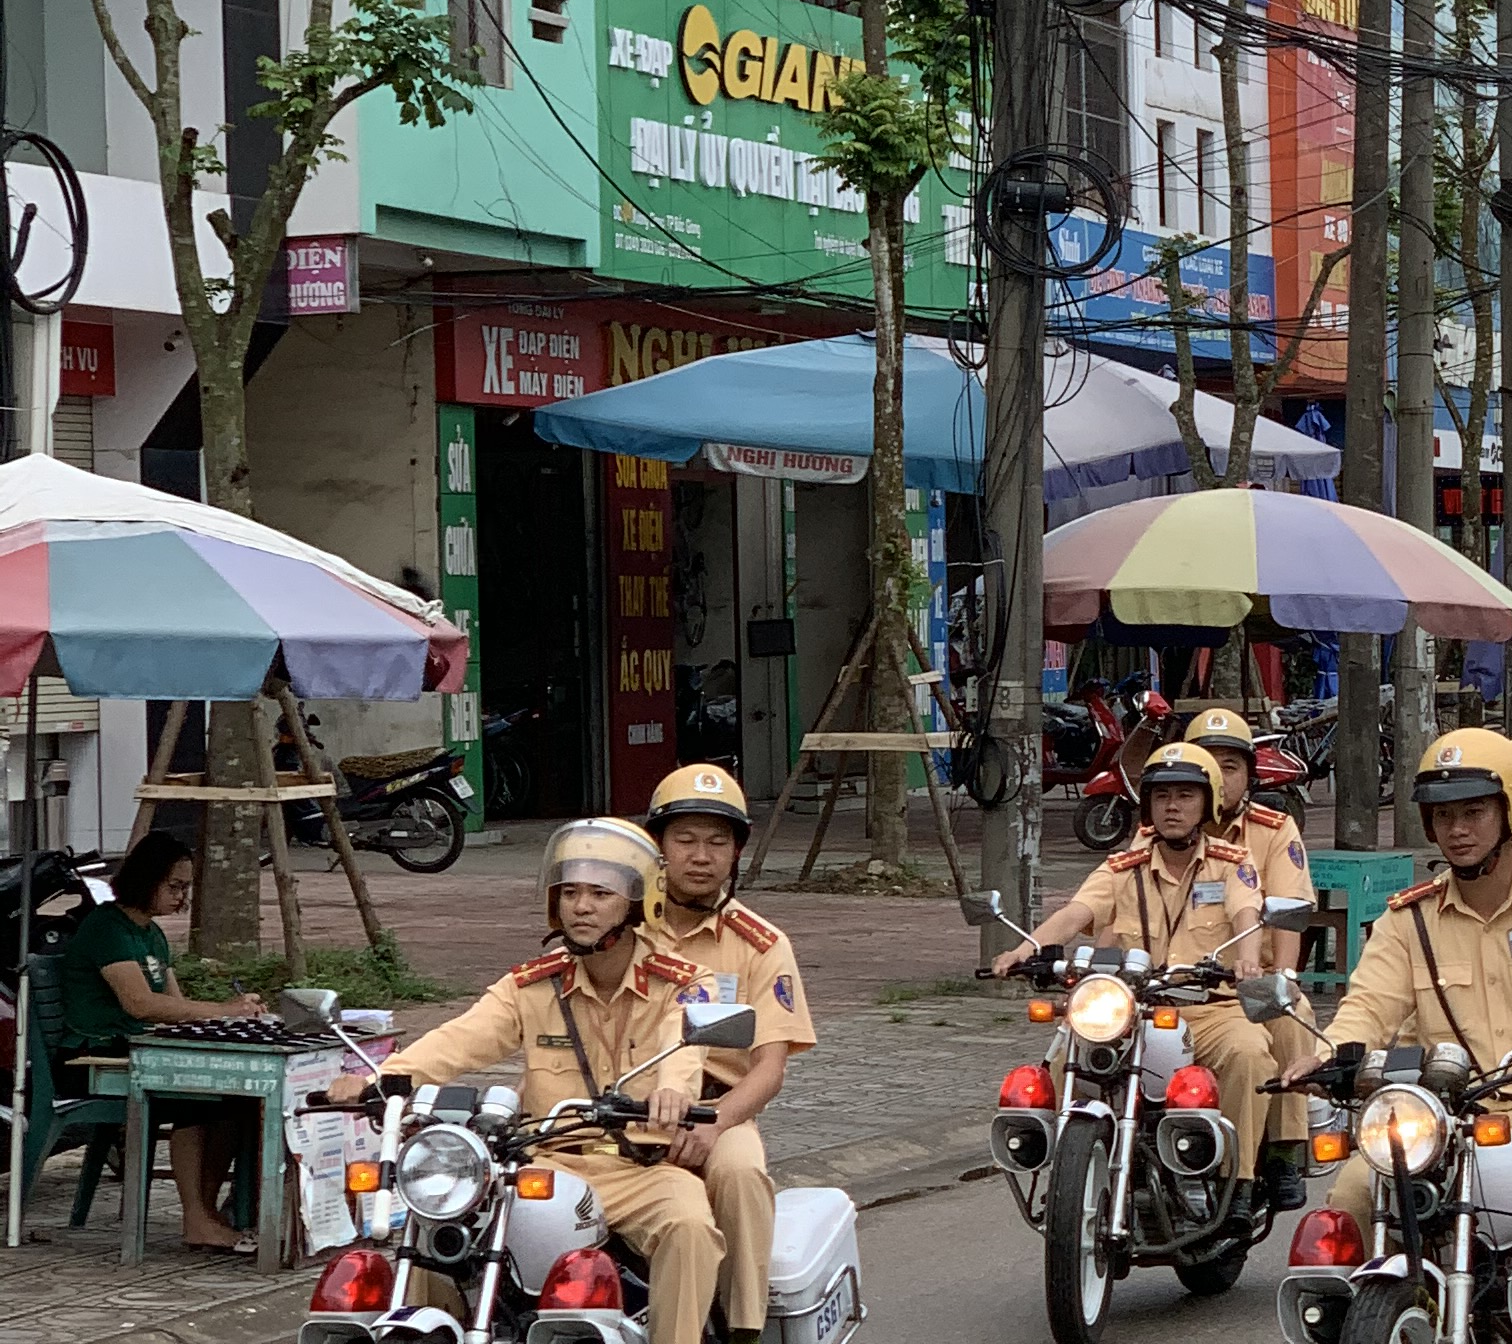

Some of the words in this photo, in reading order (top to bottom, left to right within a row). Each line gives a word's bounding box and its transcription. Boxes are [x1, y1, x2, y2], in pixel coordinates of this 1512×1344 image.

[630, 117, 669, 188] ĐẠI
[669, 115, 698, 183] LÝ
[728, 125, 795, 198] QUYỀN
[76, 346, 99, 381] VỤ
[482, 324, 515, 396] XE
[518, 330, 546, 362] ĐẠP
[548, 329, 581, 365] ĐIỆN
[519, 367, 548, 398] MÁY
[553, 370, 585, 399] ĐIỆN
[727, 445, 777, 470] NGHỊ
[621, 509, 637, 551] XE
[619, 576, 646, 617] THAY
[244, 1078, 278, 1092] 8177
[816, 1291, 842, 1341] CSGT
